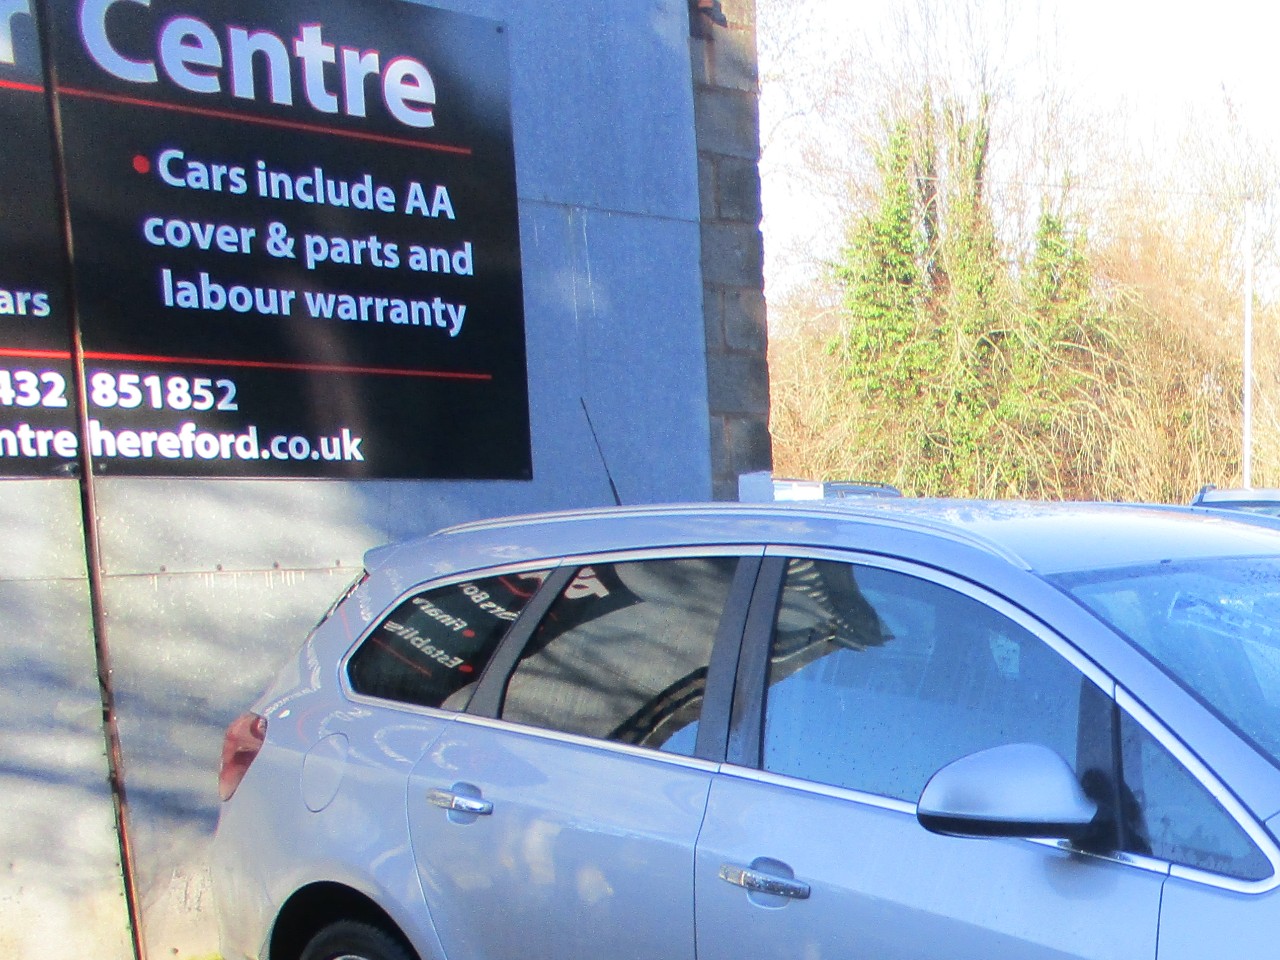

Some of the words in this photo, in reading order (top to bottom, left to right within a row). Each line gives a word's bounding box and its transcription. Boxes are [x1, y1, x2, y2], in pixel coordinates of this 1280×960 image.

[80, 0, 437, 128] Centre
[158, 149, 248, 195] Cars
[256, 160, 396, 213] include
[406, 182, 456, 220] AA
[144, 217, 256, 254] cover
[266, 221, 297, 259] &
[305, 234, 400, 270] parts
[409, 242, 474, 276] and
[162, 268, 296, 316] labour
[304, 291, 467, 337] warranty
[91, 372, 239, 412] 851852
